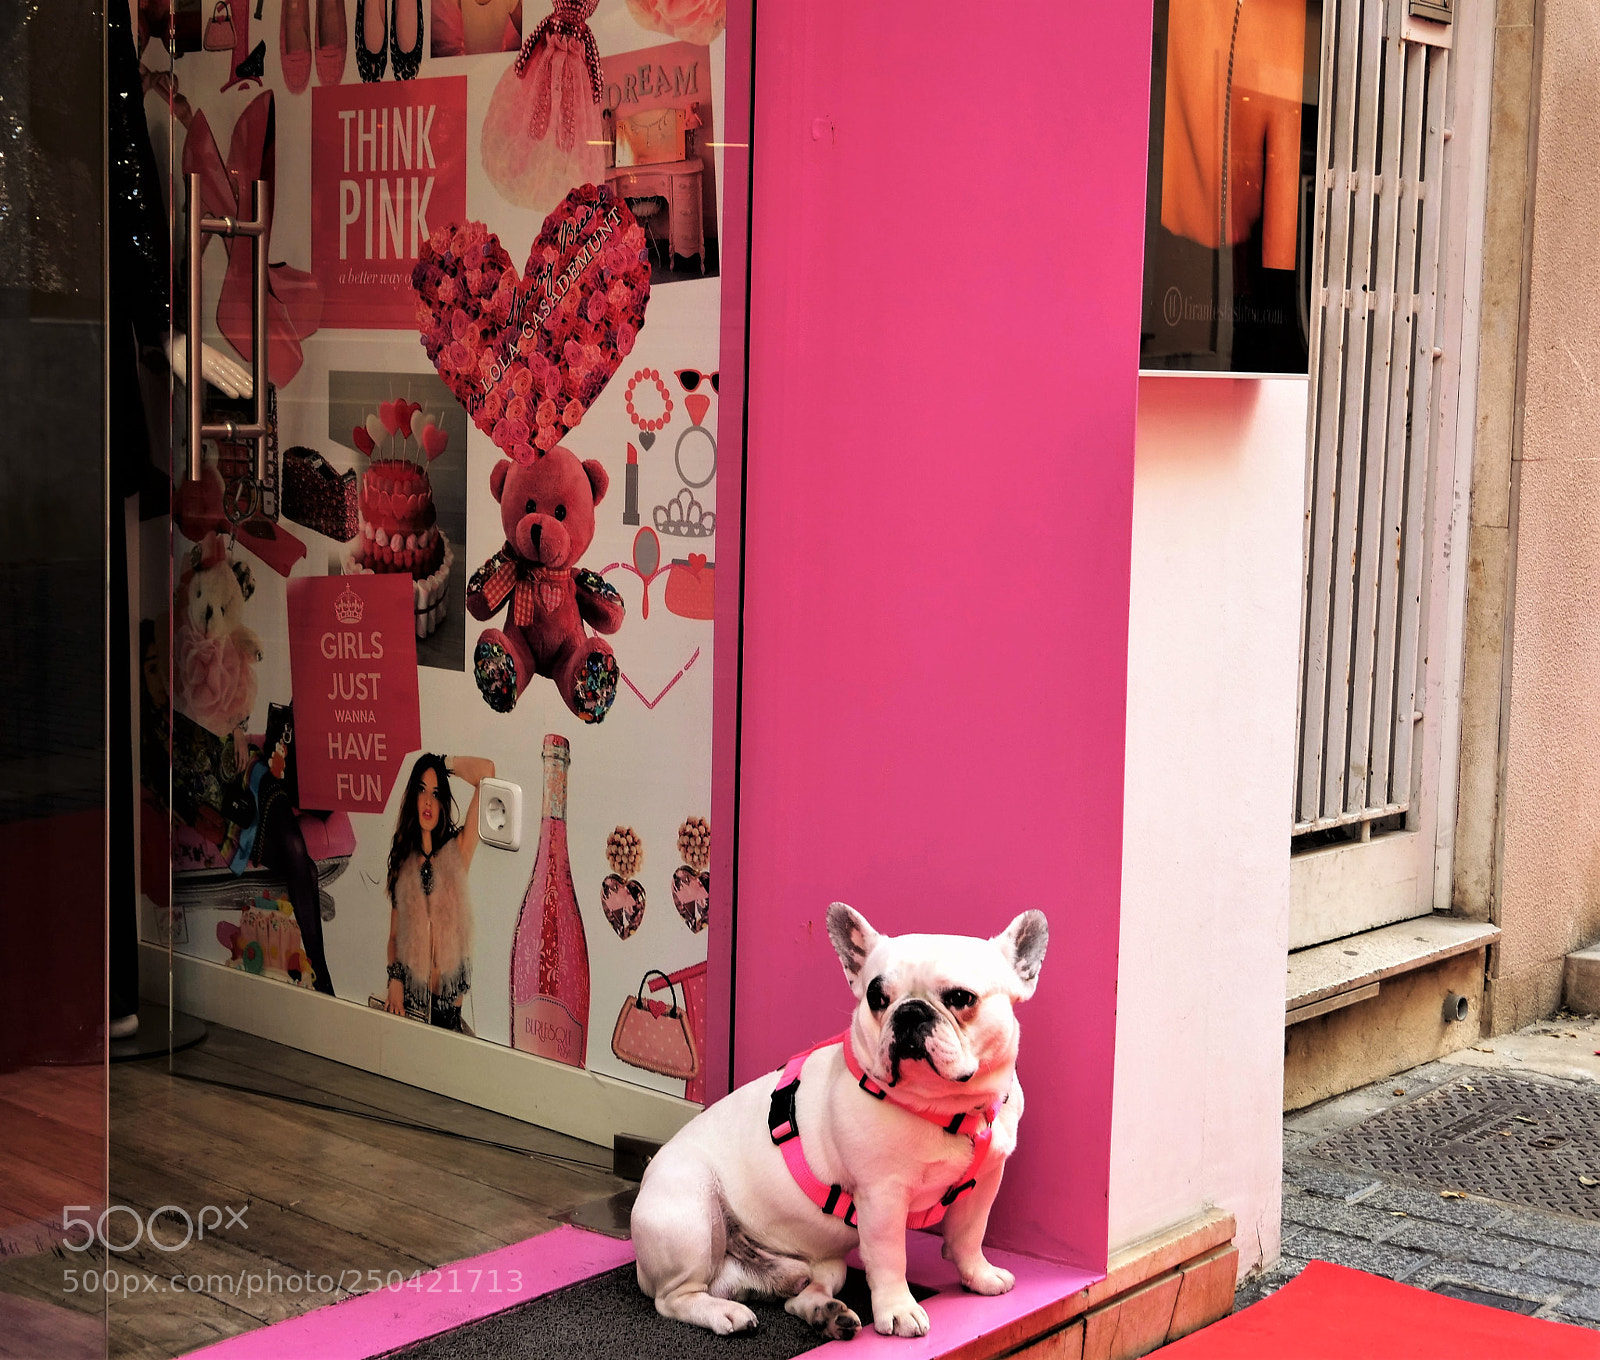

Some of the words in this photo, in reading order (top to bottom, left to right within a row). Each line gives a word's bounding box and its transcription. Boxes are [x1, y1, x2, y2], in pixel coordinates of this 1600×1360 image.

[602, 61, 698, 111] DREAM
[338, 104, 436, 172] THINK
[339, 176, 435, 260] PINK
[338, 273, 346, 284] a
[347, 267, 378, 284] better
[379, 273, 402, 291] way
[479, 342, 521, 394] LOLA
[522, 206, 624, 340] CASADEMUNT
[320, 631, 384, 659] GIRLS
[327, 672, 381, 700] JUST
[334, 709, 377, 723] WANNA
[327, 732, 387, 761] HAVE
[336, 773, 382, 802] FUN
